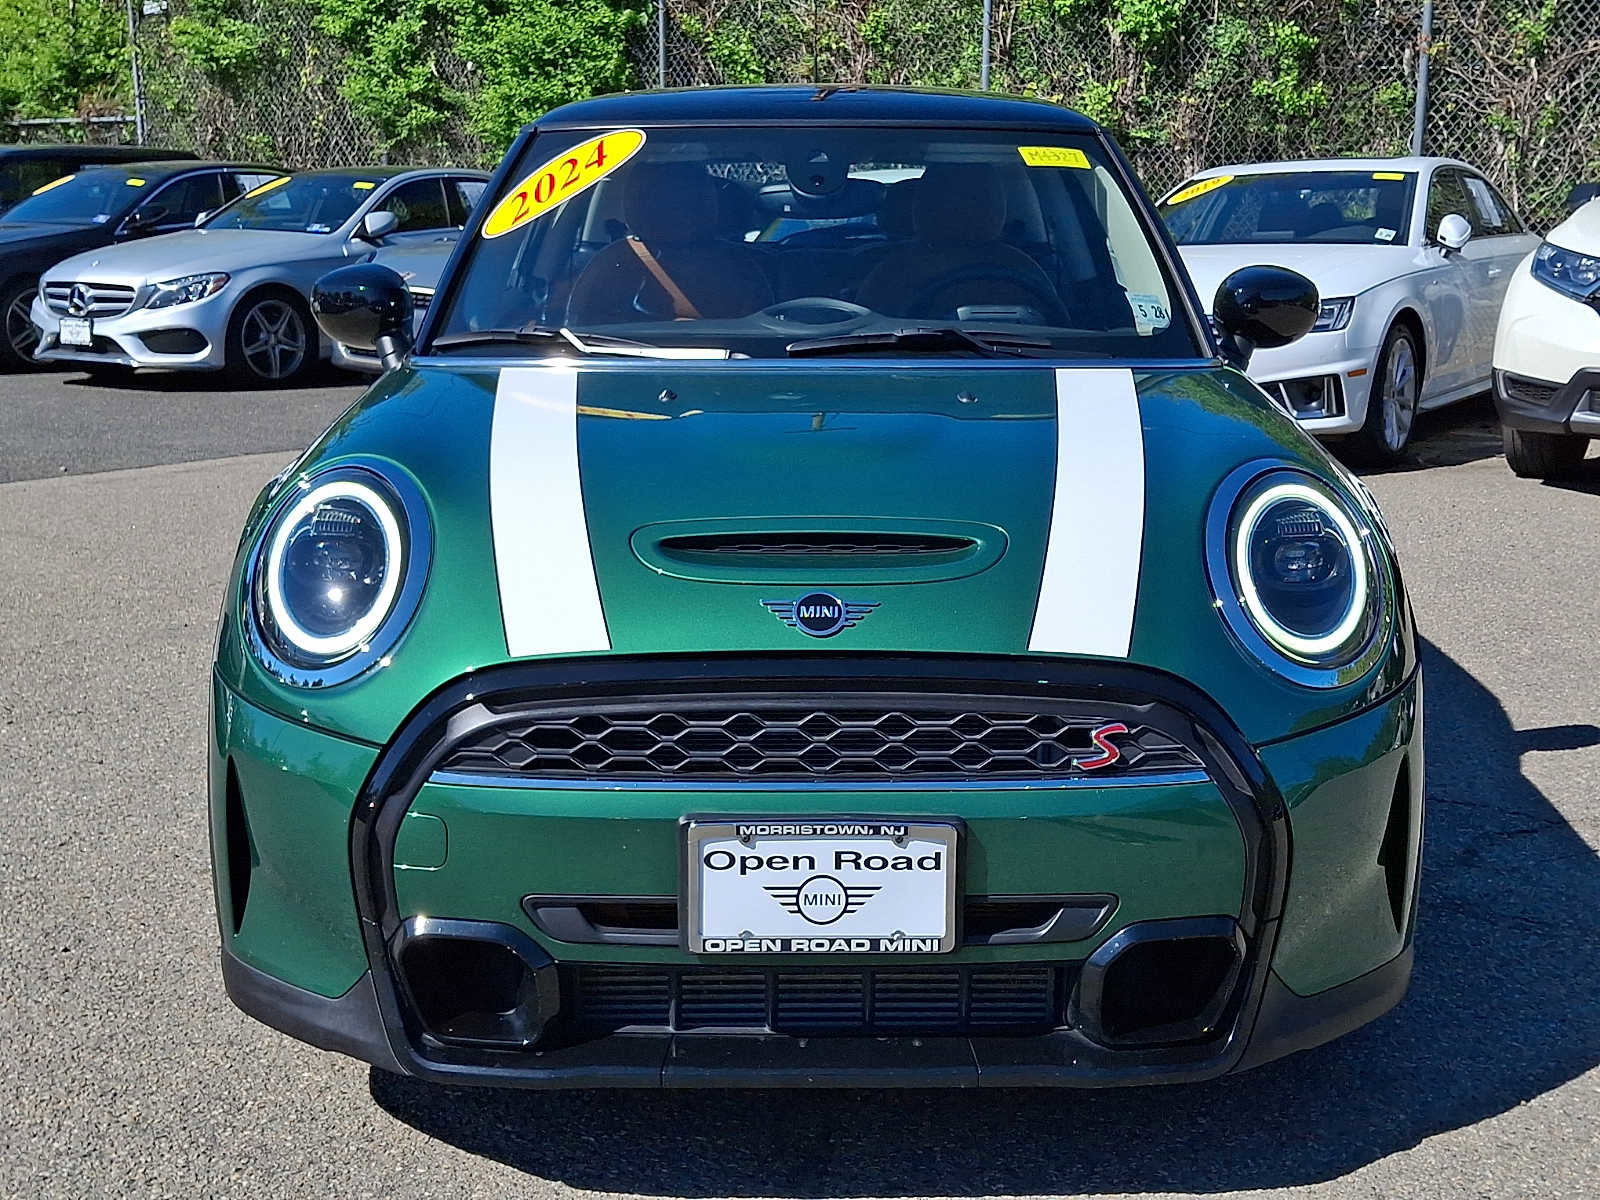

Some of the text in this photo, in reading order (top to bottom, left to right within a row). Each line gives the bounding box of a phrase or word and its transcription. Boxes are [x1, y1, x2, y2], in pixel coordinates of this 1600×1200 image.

[511, 140, 608, 226] 2024
[1137, 304, 1148, 318] 5
[799, 605, 839, 618] MINI
[1071, 722, 1129, 771] S
[739, 825, 906, 836] MORRISTOWN, NJ
[703, 850, 942, 875] Open Road
[803, 893, 842, 906] MINI
[704, 938, 940, 953] OPEN ROAD MINI
